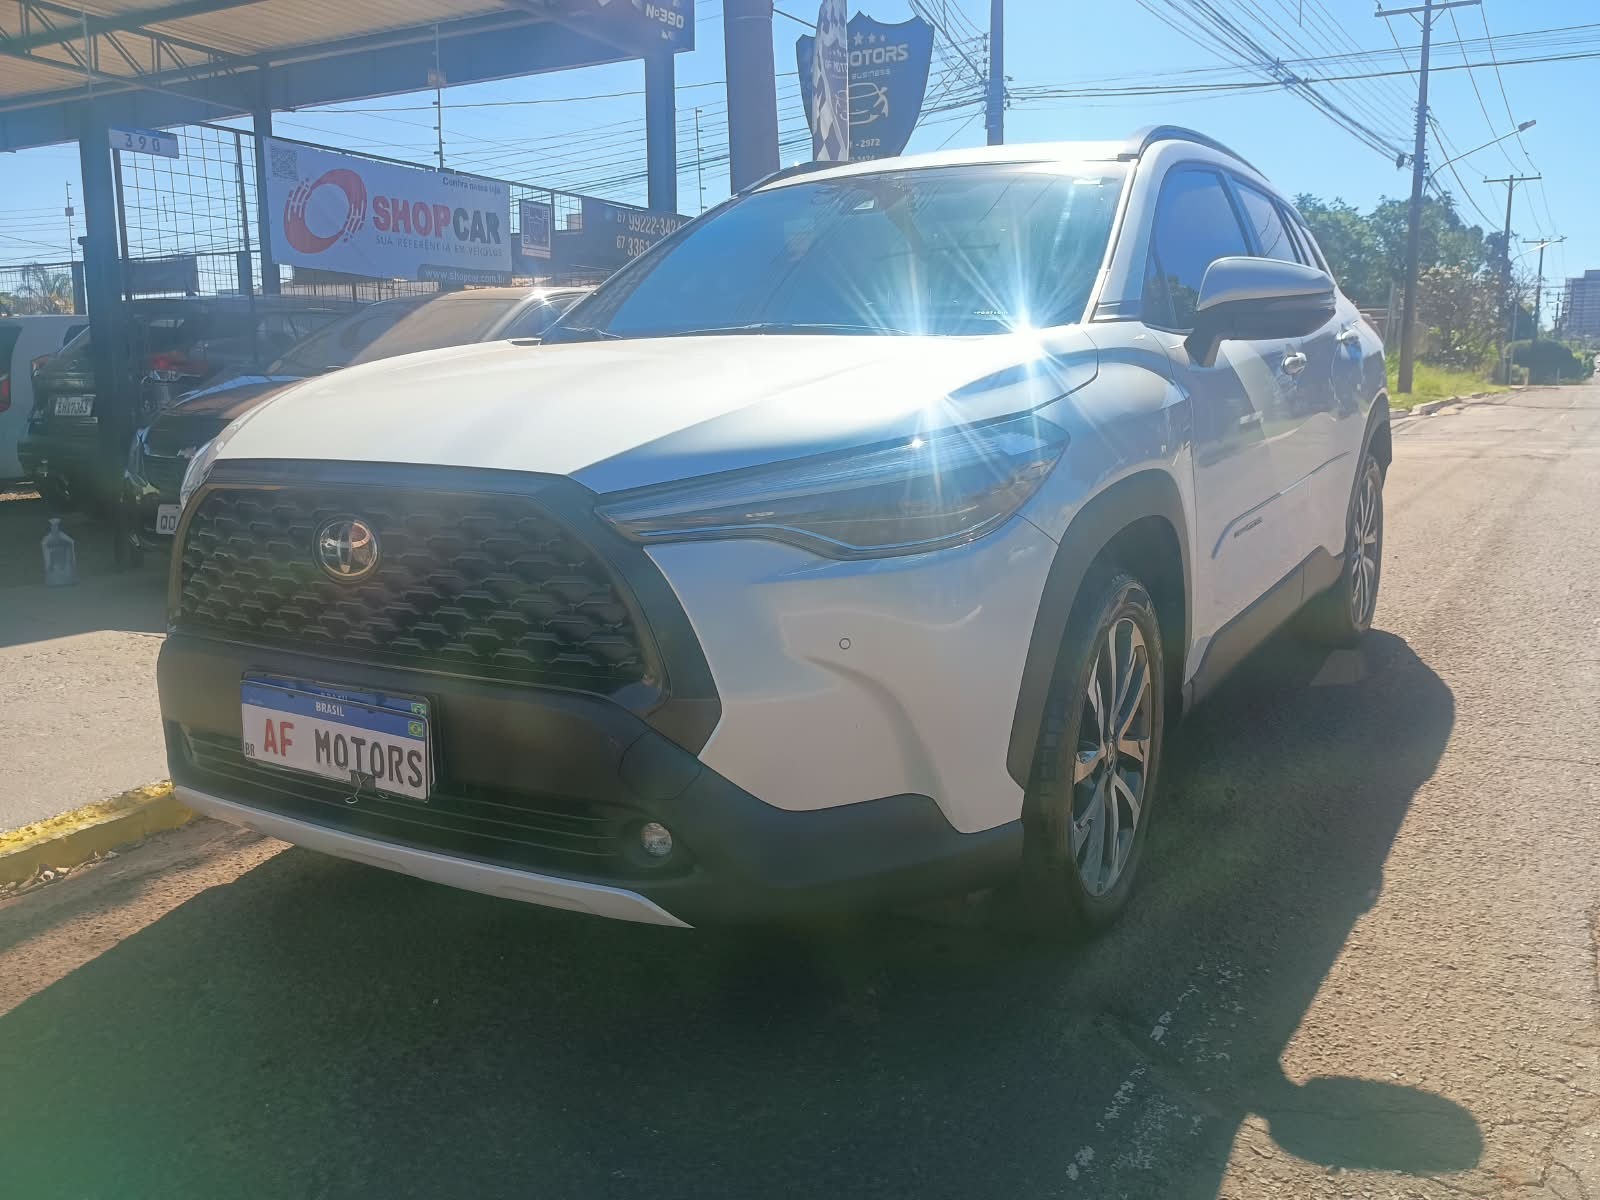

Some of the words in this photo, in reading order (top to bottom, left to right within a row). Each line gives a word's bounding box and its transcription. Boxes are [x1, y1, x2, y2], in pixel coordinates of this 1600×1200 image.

[847, 44, 909, 66] OTORS
[125, 133, 160, 152] 390
[372, 195, 501, 245] SHOPCAR
[376, 235, 393, 245] SUA
[315, 701, 345, 718] BRASIL
[244, 741, 256, 757] BR
[263, 718, 295, 757] AF
[314, 727, 423, 789] MOTORS
